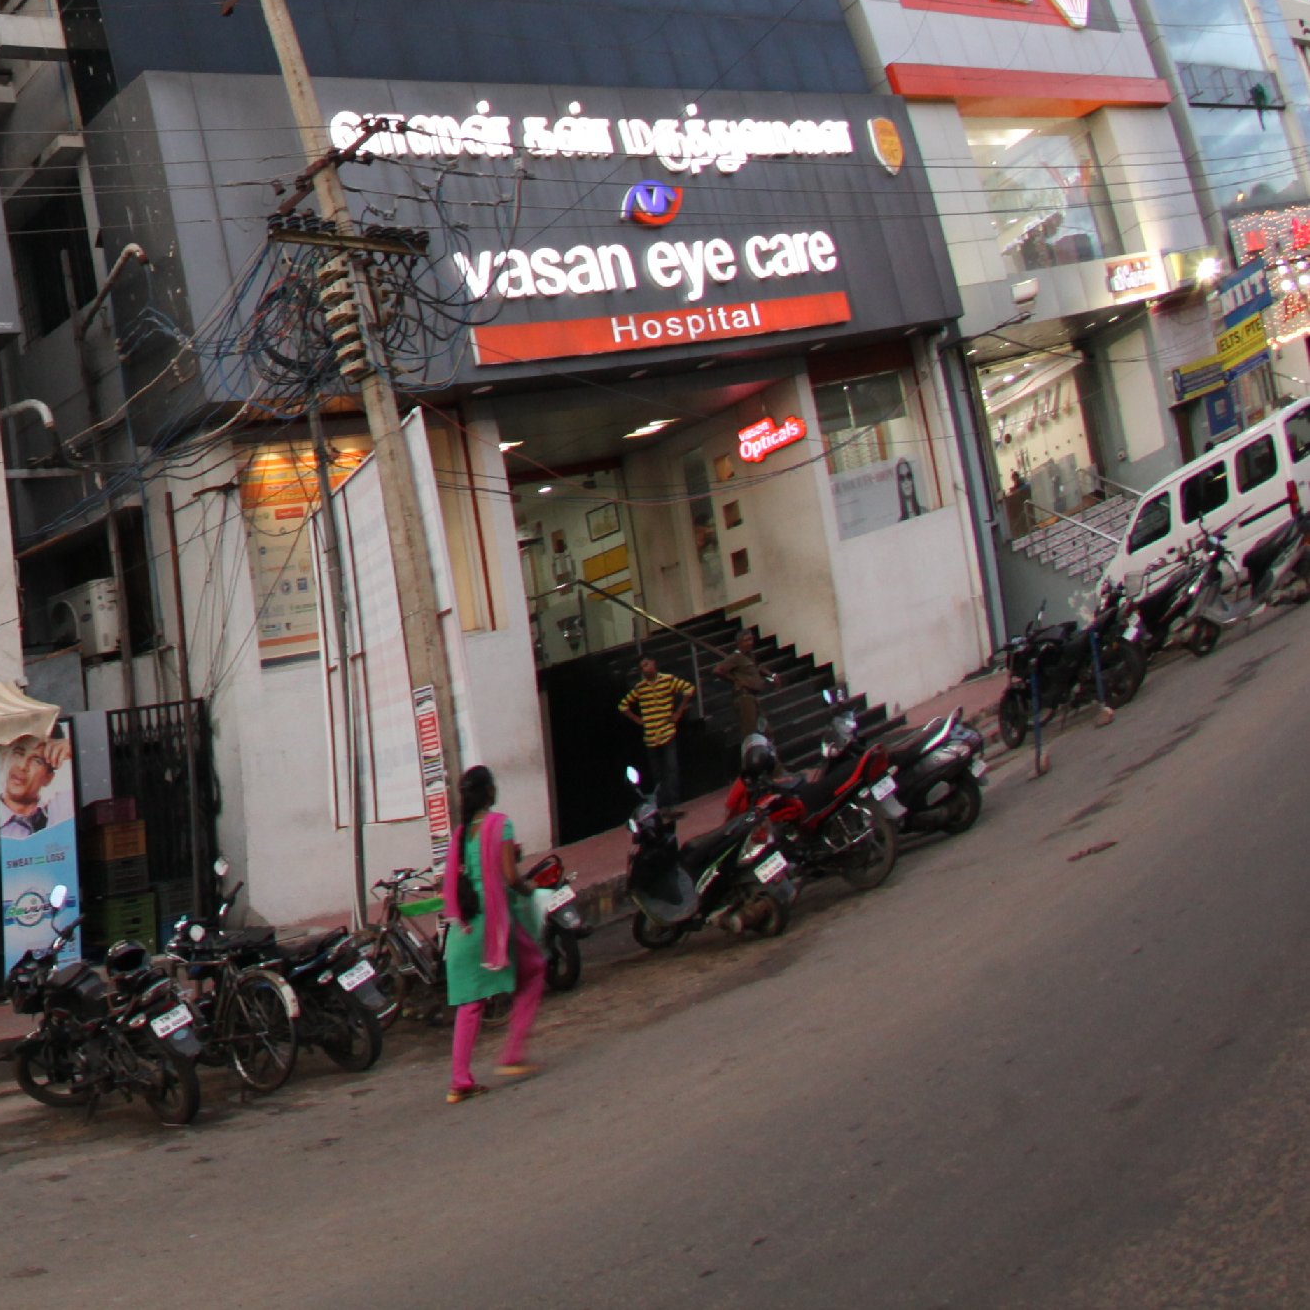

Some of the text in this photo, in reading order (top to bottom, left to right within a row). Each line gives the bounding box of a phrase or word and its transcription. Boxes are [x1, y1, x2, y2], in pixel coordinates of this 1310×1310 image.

[454, 229, 838, 301] vasan eye care
[1220, 269, 1267, 316] NIIT
[610, 301, 762, 345] Hospital
[739, 421, 799, 459] Opticals
[6, 851, 66, 869] SWEAT LOSS
